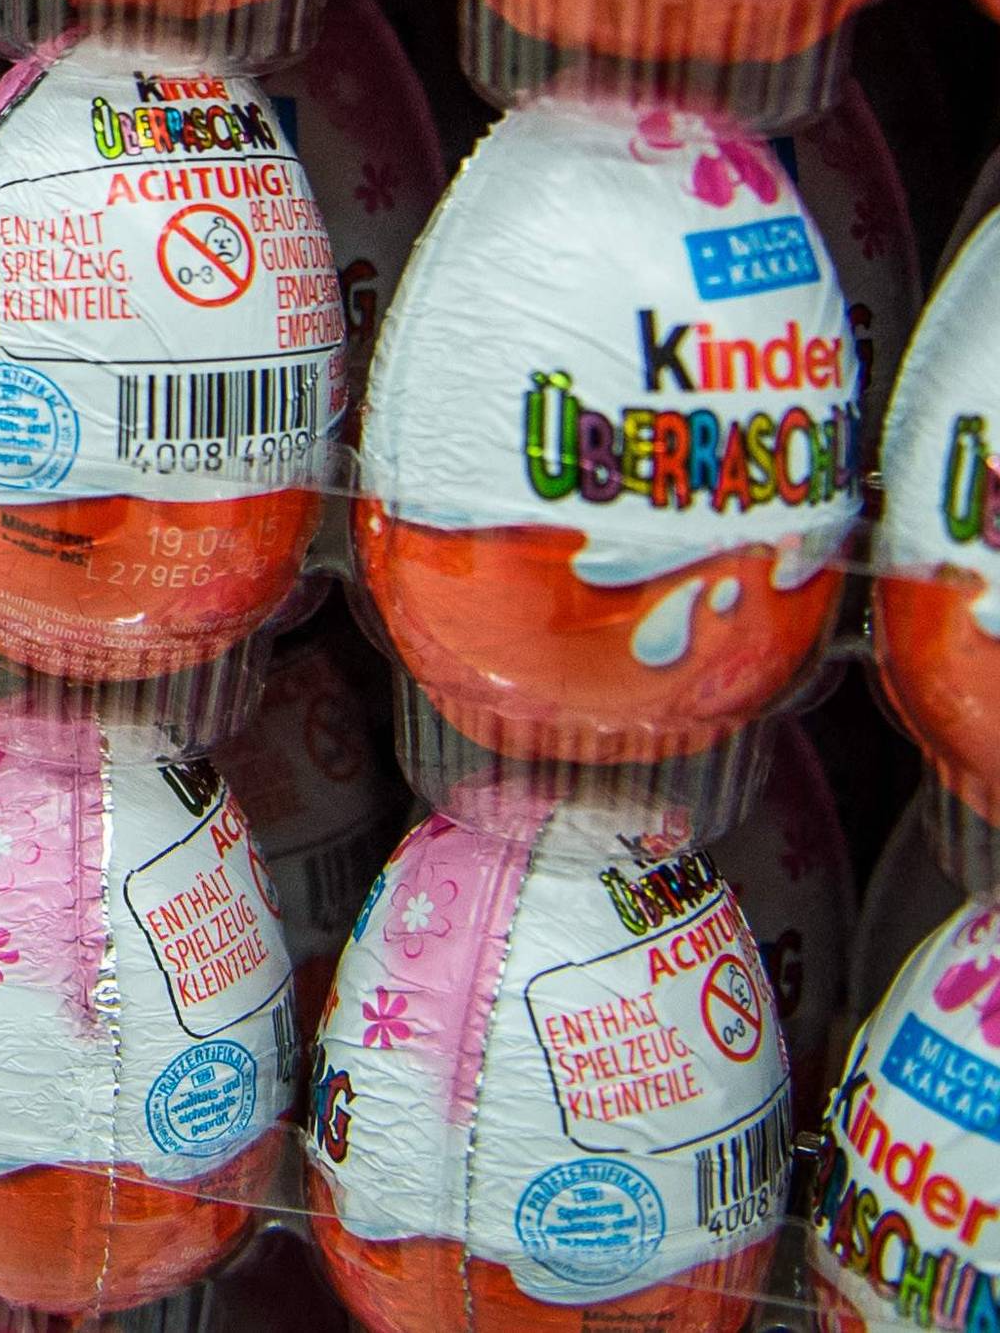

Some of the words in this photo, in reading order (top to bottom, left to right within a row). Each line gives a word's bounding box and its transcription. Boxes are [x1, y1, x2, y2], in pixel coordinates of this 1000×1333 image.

[107, 163, 293, 206] ACHTUNG!
[177, 265, 216, 285] 0-3
[3, 286, 141, 322] KLEINTEILE.
[131, 442, 223, 475] 4008
[146, 865, 233, 941] ENTHÄLT
[164, 894, 258, 974] SPIELZEUG.
[177, 928, 270, 1008] KLEINTEILE.
[557, 1026, 694, 1086] SPIELZEUG.
[723, 1018, 747, 1046] 0-3
[836, 1043, 1000, 1247] Kinder
[709, 1186, 769, 1237] 4008
